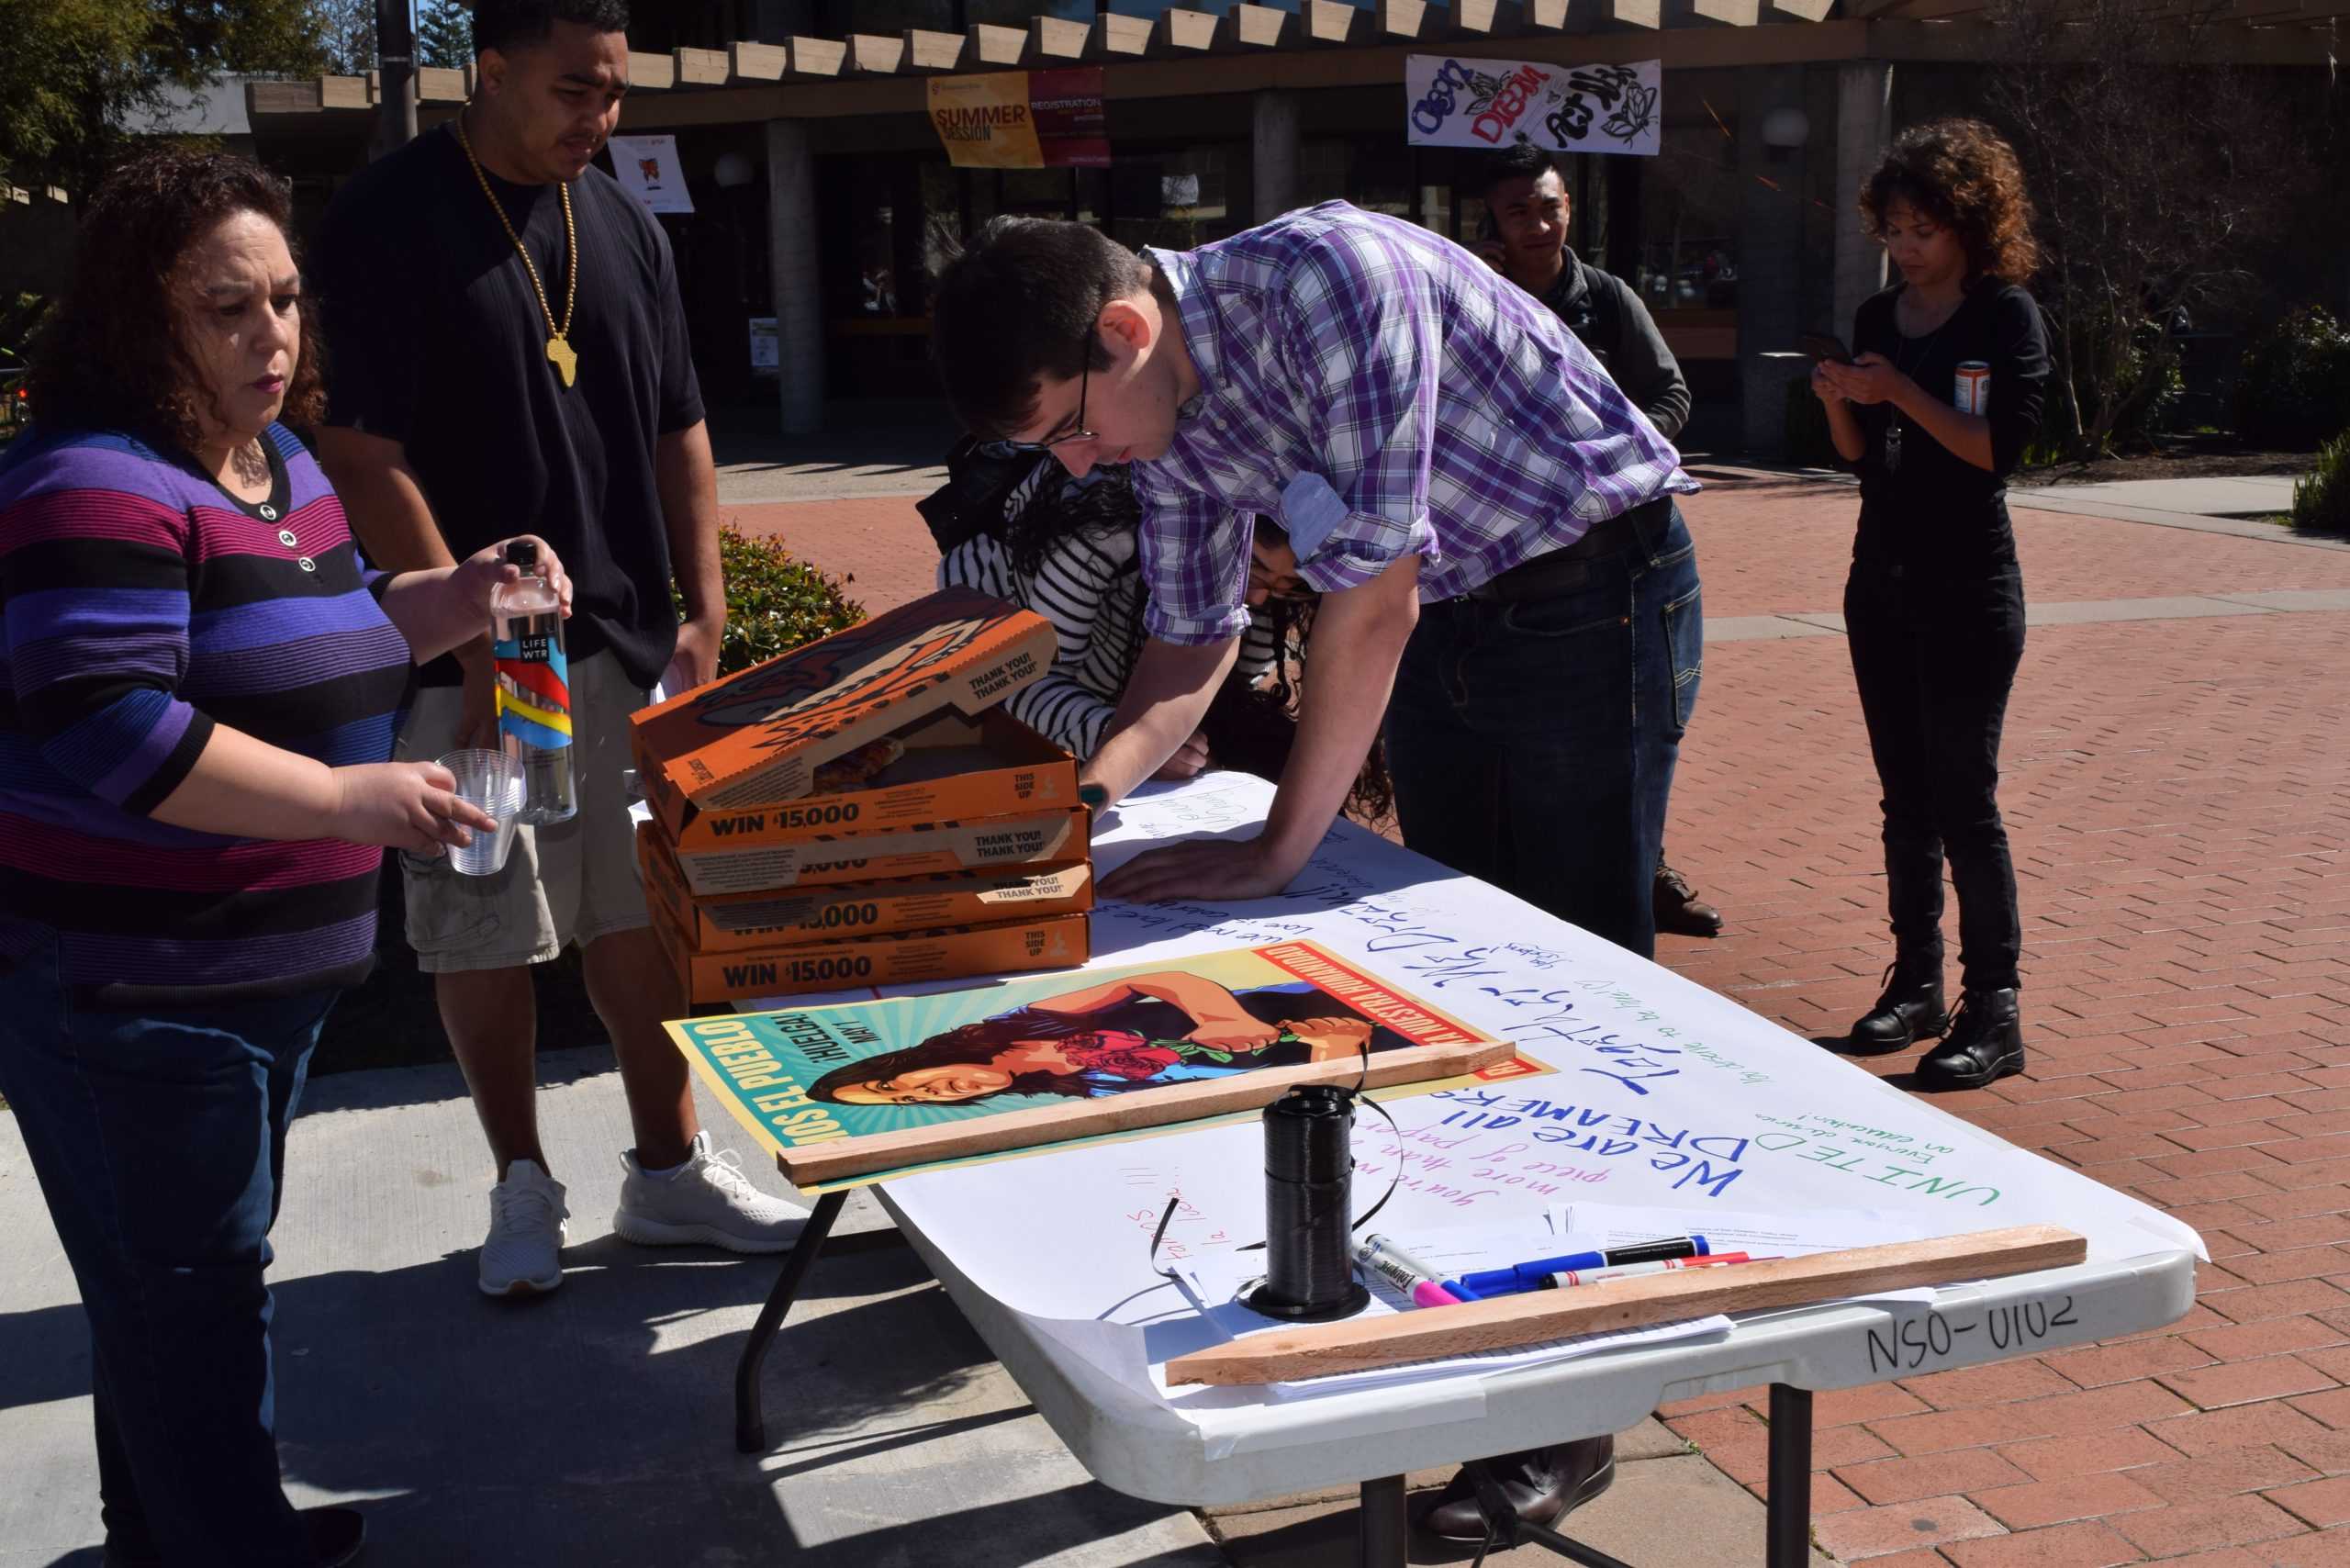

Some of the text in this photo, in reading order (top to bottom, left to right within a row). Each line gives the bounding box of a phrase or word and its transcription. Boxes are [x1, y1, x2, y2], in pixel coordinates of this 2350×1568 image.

[1030, 97, 1102, 111] REGISTRATION
[936, 104, 1026, 128] SUMMER
[943, 125, 991, 142] SESSION
[521, 638, 548, 650] LIFE
[522, 649, 548, 660] WTR
[968, 651, 1033, 689] THANK YOU!
[973, 675, 1012, 700] THANK
[1013, 772, 1035, 782] THIS
[1013, 781, 1035, 791] SIDE
[1018, 790, 1032, 801] UP
[709, 814, 765, 837] WIN
[773, 802, 860, 829] $15,000
[975, 830, 1042, 846] THANK YOU!
[976, 841, 1044, 857] THANK YOU!
[1033, 877, 1058, 887] YOU!
[997, 889, 1035, 899] THANK
[1025, 930, 1046, 940] THIS
[1025, 938, 1046, 949] SIDE
[1029, 947, 1043, 957] UP
[721, 963, 778, 989] WIN
[786, 956, 872, 983] $15,000
[1263, 946, 1452, 1035] NUESTRA HUMANIDAD
[1637, 1010, 1661, 1022] be
[770, 1014, 852, 1064] ¡HUELGA!
[836, 1025, 882, 1045] MAY
[1658, 1027, 1682, 1038] to
[693, 1019, 795, 1091] PUEBLO
[1683, 1041, 1745, 1070] deserve
[752, 1084, 817, 1114] EL
[1798, 1111, 1954, 1154] an education!
[1379, 1143, 1453, 1173] than
[1440, 1109, 1744, 1197] We are all
[1468, 1142, 1529, 1163] of
[1850, 1136, 1936, 1165] Everyone
[1523, 1159, 1614, 1184] piece
[1754, 1132, 2001, 1206] UNITED
[1472, 1166, 1561, 1195] more
